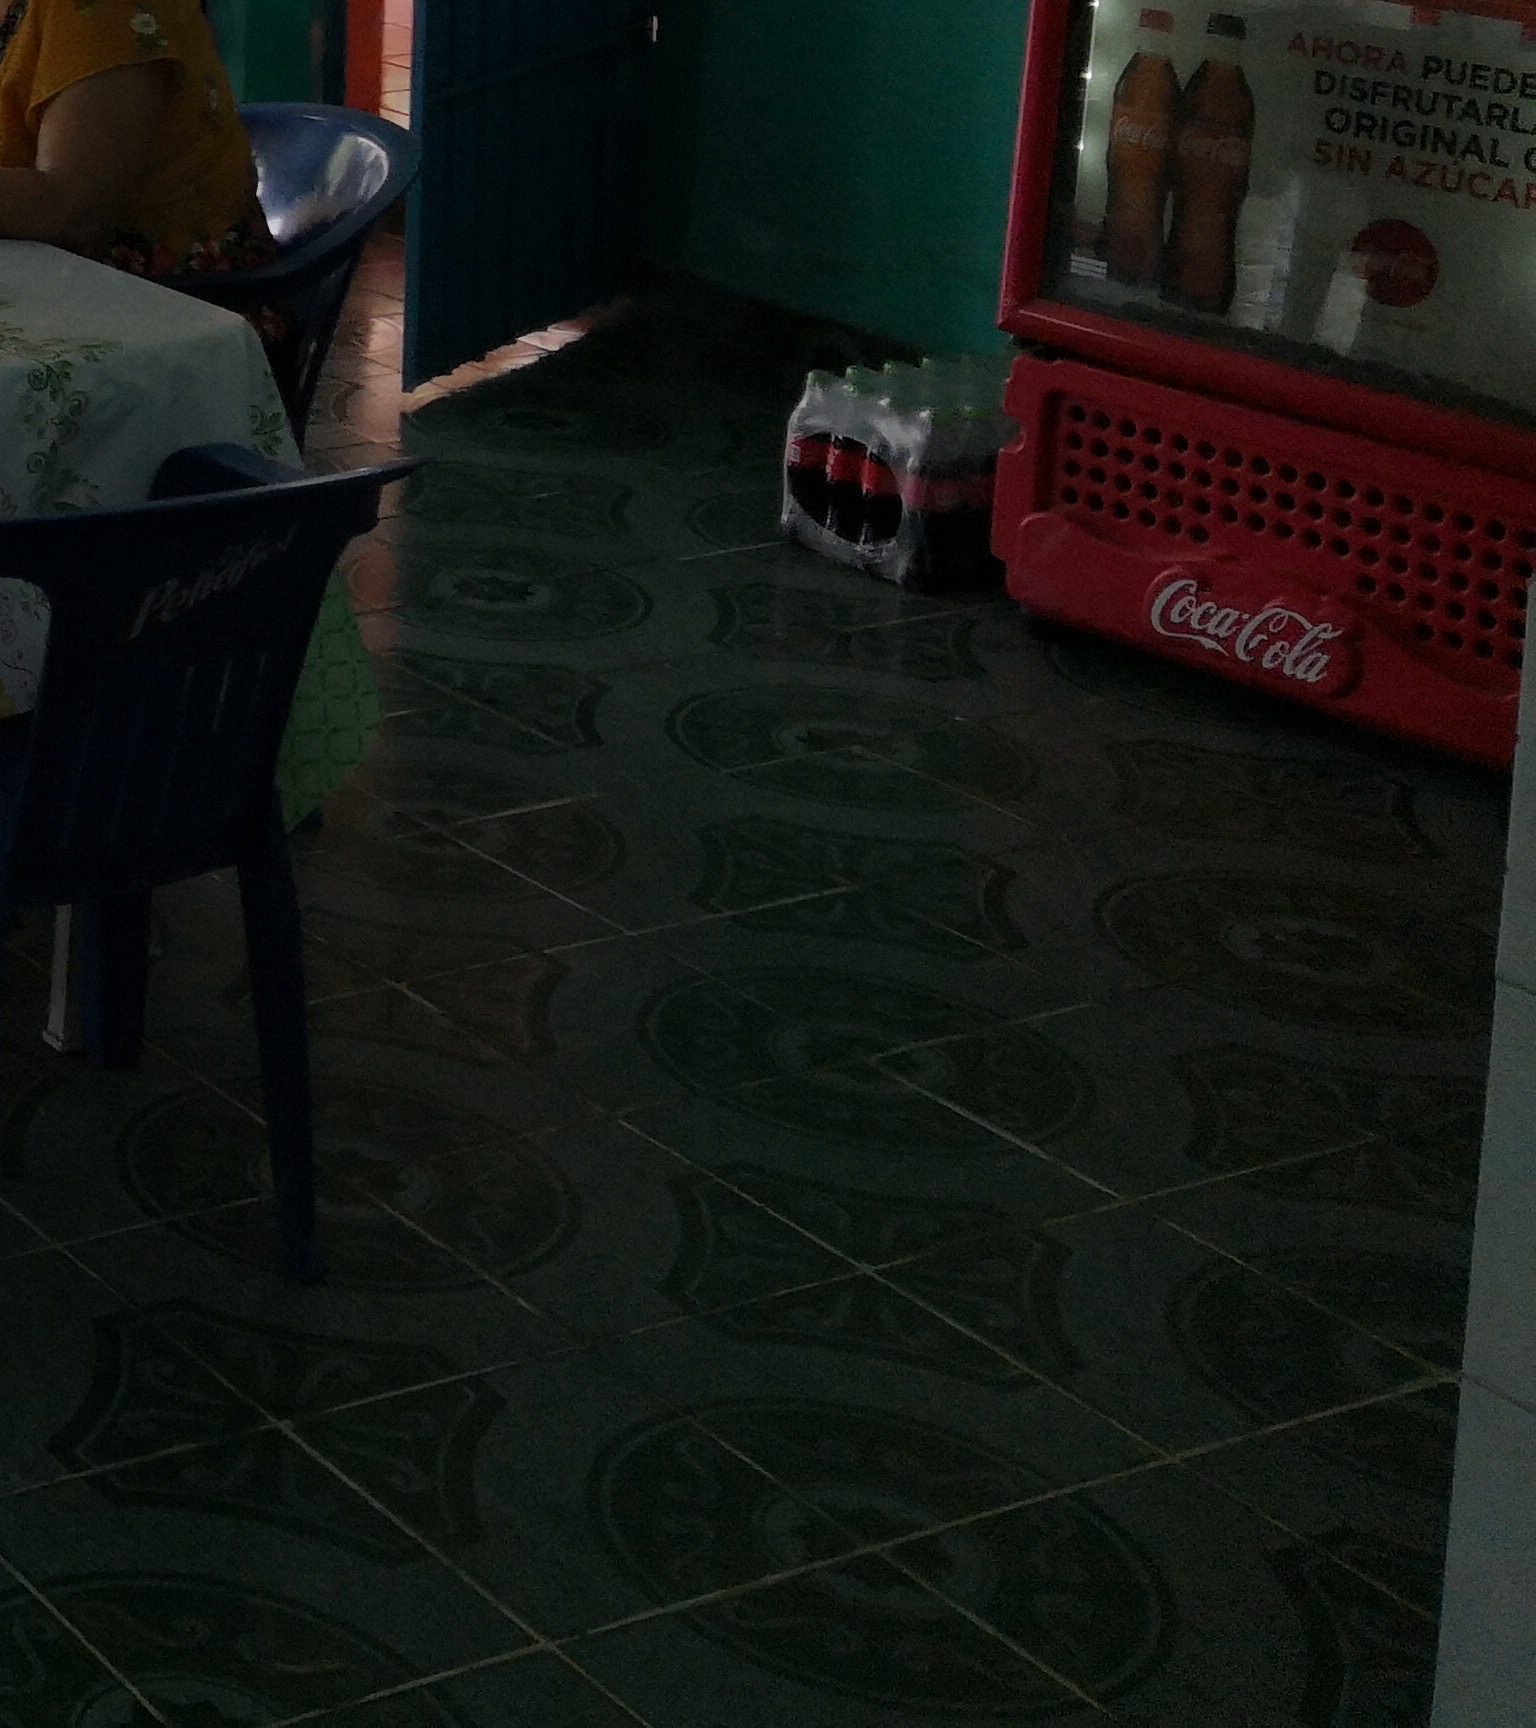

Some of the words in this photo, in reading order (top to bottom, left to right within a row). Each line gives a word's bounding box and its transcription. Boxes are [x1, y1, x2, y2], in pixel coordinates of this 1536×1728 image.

[1288, 32, 1407, 72] AHORA
[1314, 70, 1536, 134] DISFRUTARL
[1314, 139, 1371, 175] SIN
[1325, 107, 1509, 168] ORIGINAL
[1151, 580, 1342, 682] Coca-Cola
